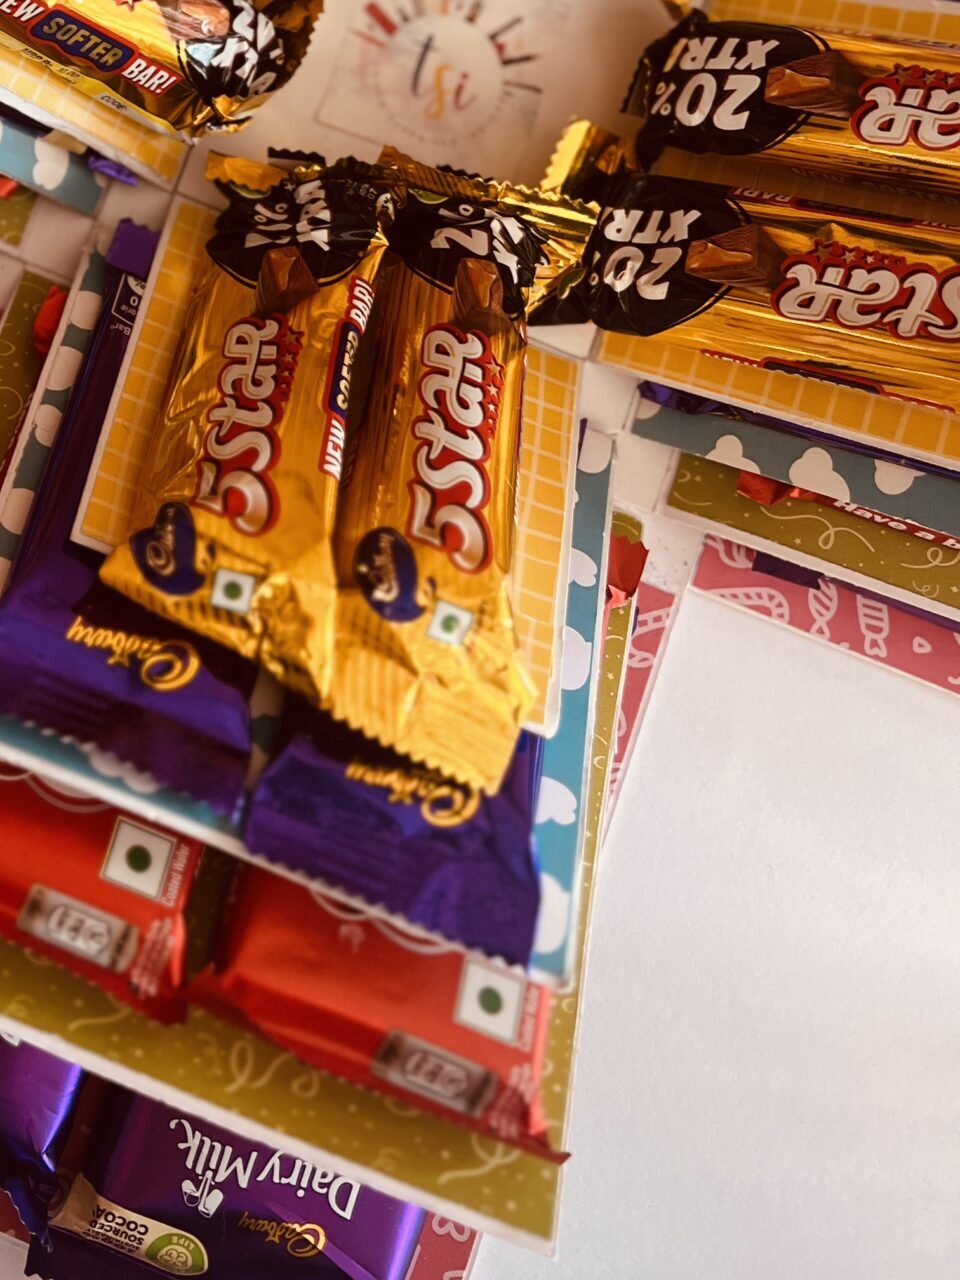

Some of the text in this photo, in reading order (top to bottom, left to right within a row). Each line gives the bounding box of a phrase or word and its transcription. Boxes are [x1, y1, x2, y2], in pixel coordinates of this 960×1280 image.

[42, 16, 126, 67] SOFTER
[121, 58, 172, 94] BAR!
[651, 73, 762, 131] 20%
[169, 1119, 258, 1189] Milk
[239, 1210, 327, 1258] Cadbury
